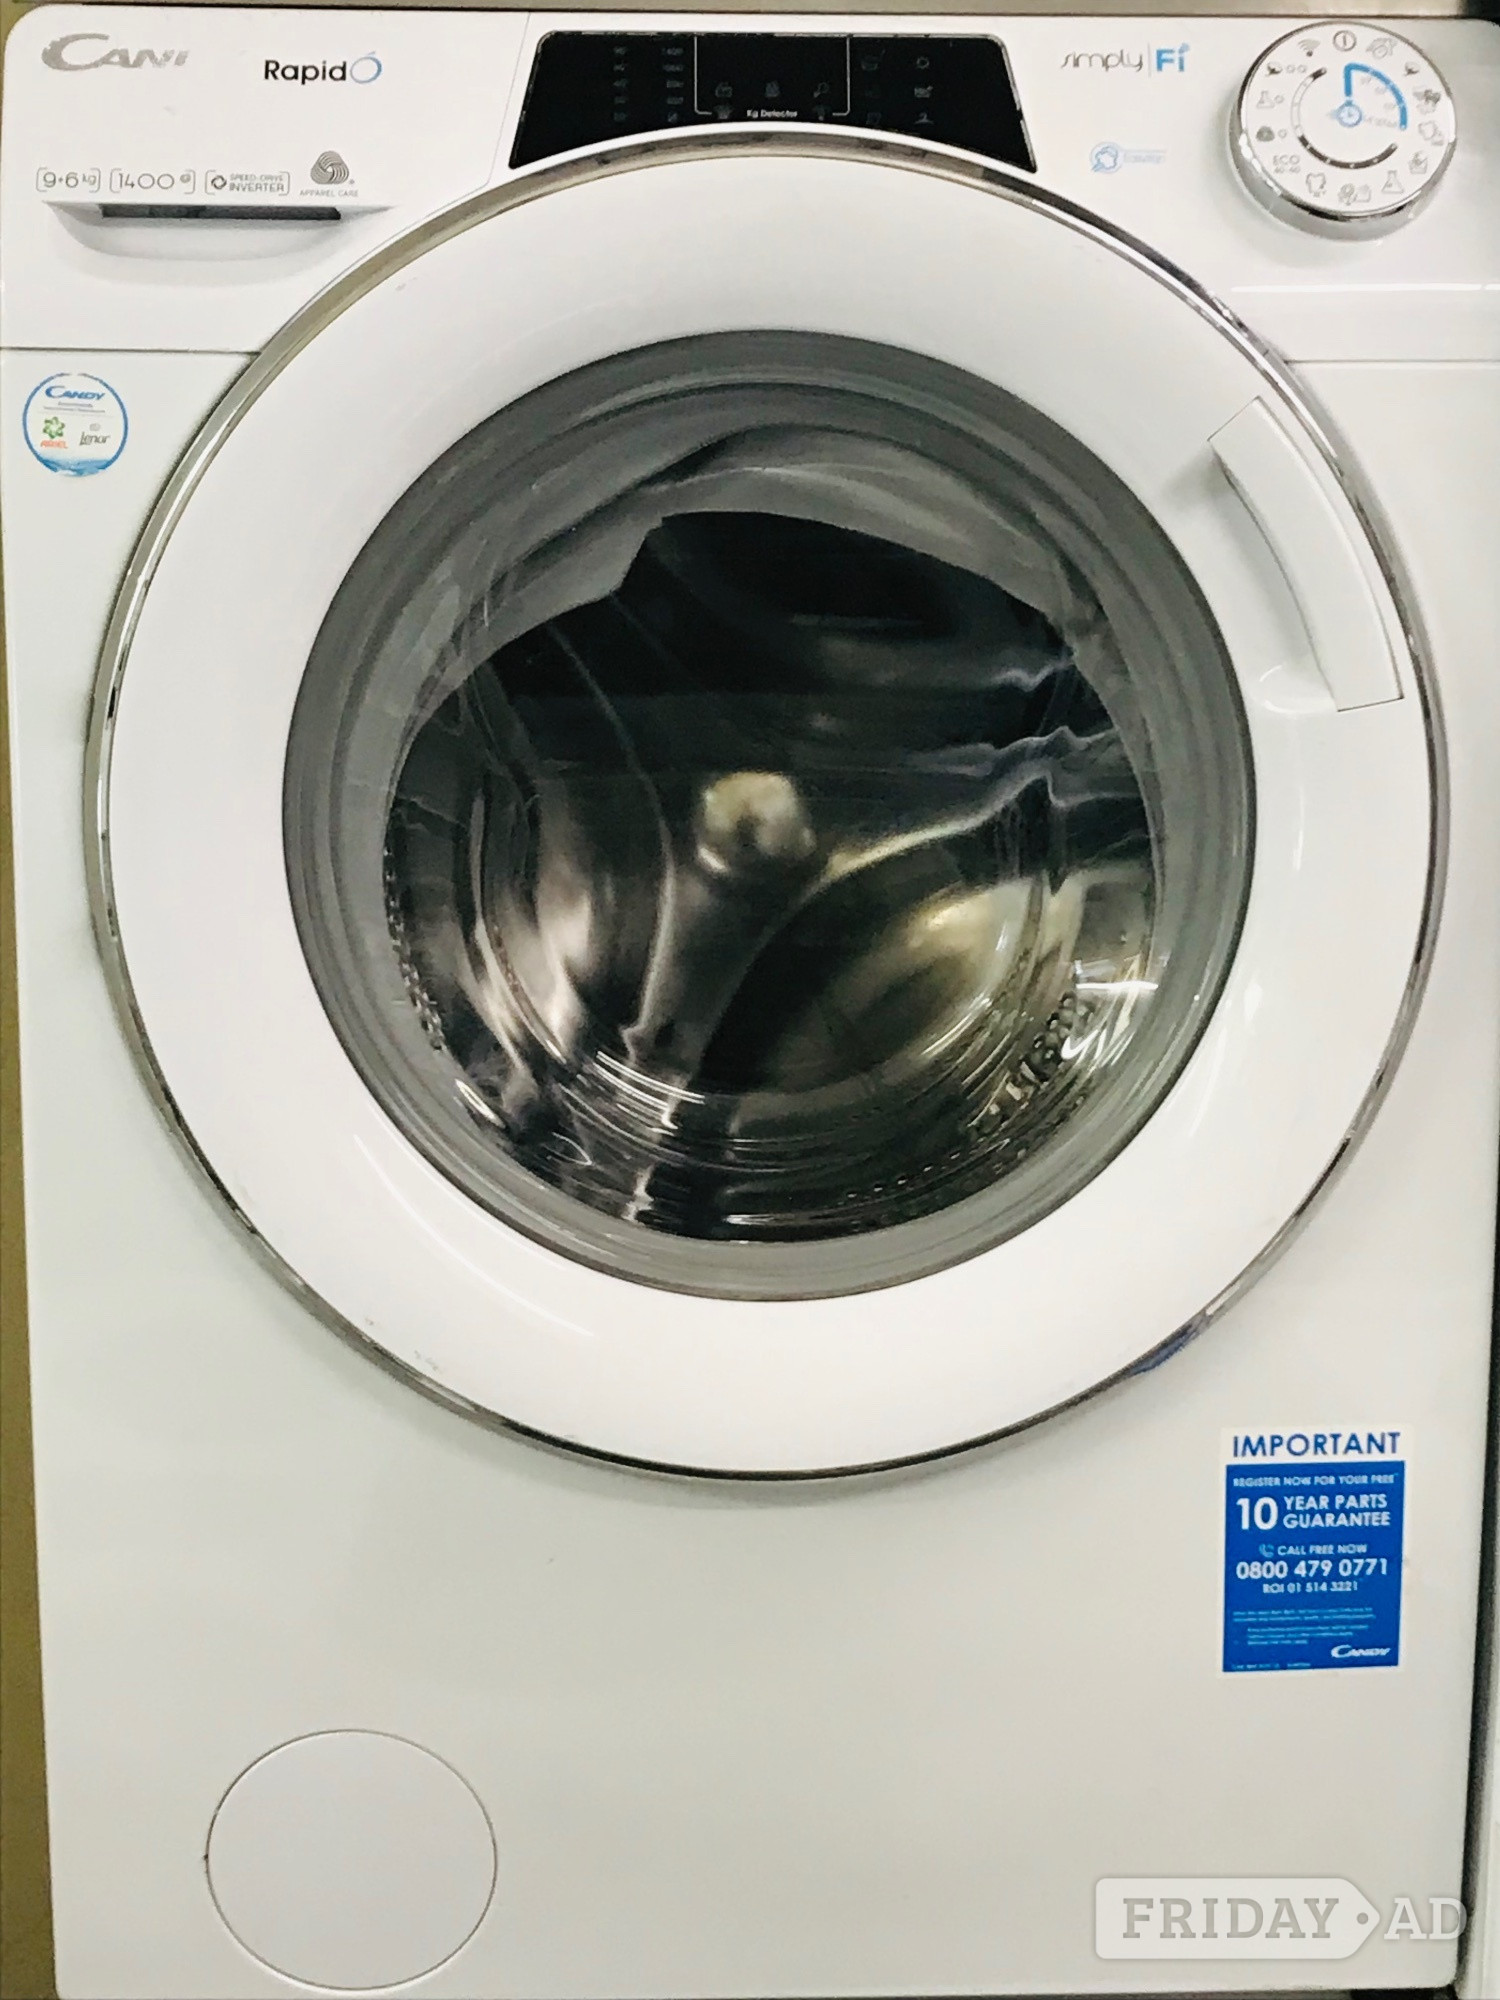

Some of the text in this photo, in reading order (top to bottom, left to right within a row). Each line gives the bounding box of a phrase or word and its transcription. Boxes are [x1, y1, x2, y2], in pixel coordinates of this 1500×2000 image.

[1061, 48, 1144, 73] simply
[1156, 42, 1190, 73] Fi
[1273, 154, 1301, 166] ECO
[118, 172, 175, 190] 1400
[229, 182, 285, 193] INVERTER
[300, 188, 359, 198] APPAREL CARE
[1233, 1432, 1401, 1458] IMPORTANT
[1233, 1477, 1281, 1487] REGISTER
[1283, 1476, 1312, 1486] NOW
[1314, 1475, 1336, 1486] FOR
[1339, 1474, 1369, 1485] YOUR
[1236, 1493, 1388, 1531] 10 YEAR PARTS
[1282, 1512, 1391, 1529] GUARANTEE
[1277, 1543, 1368, 1556] CALL FREE NOW
[1236, 1558, 1388, 1580] 0800 479 0771
[1262, 1583, 1285, 1594] ROI
[1286, 1583, 1302, 1594] 01
[1305, 1582, 1328, 1593] 514
